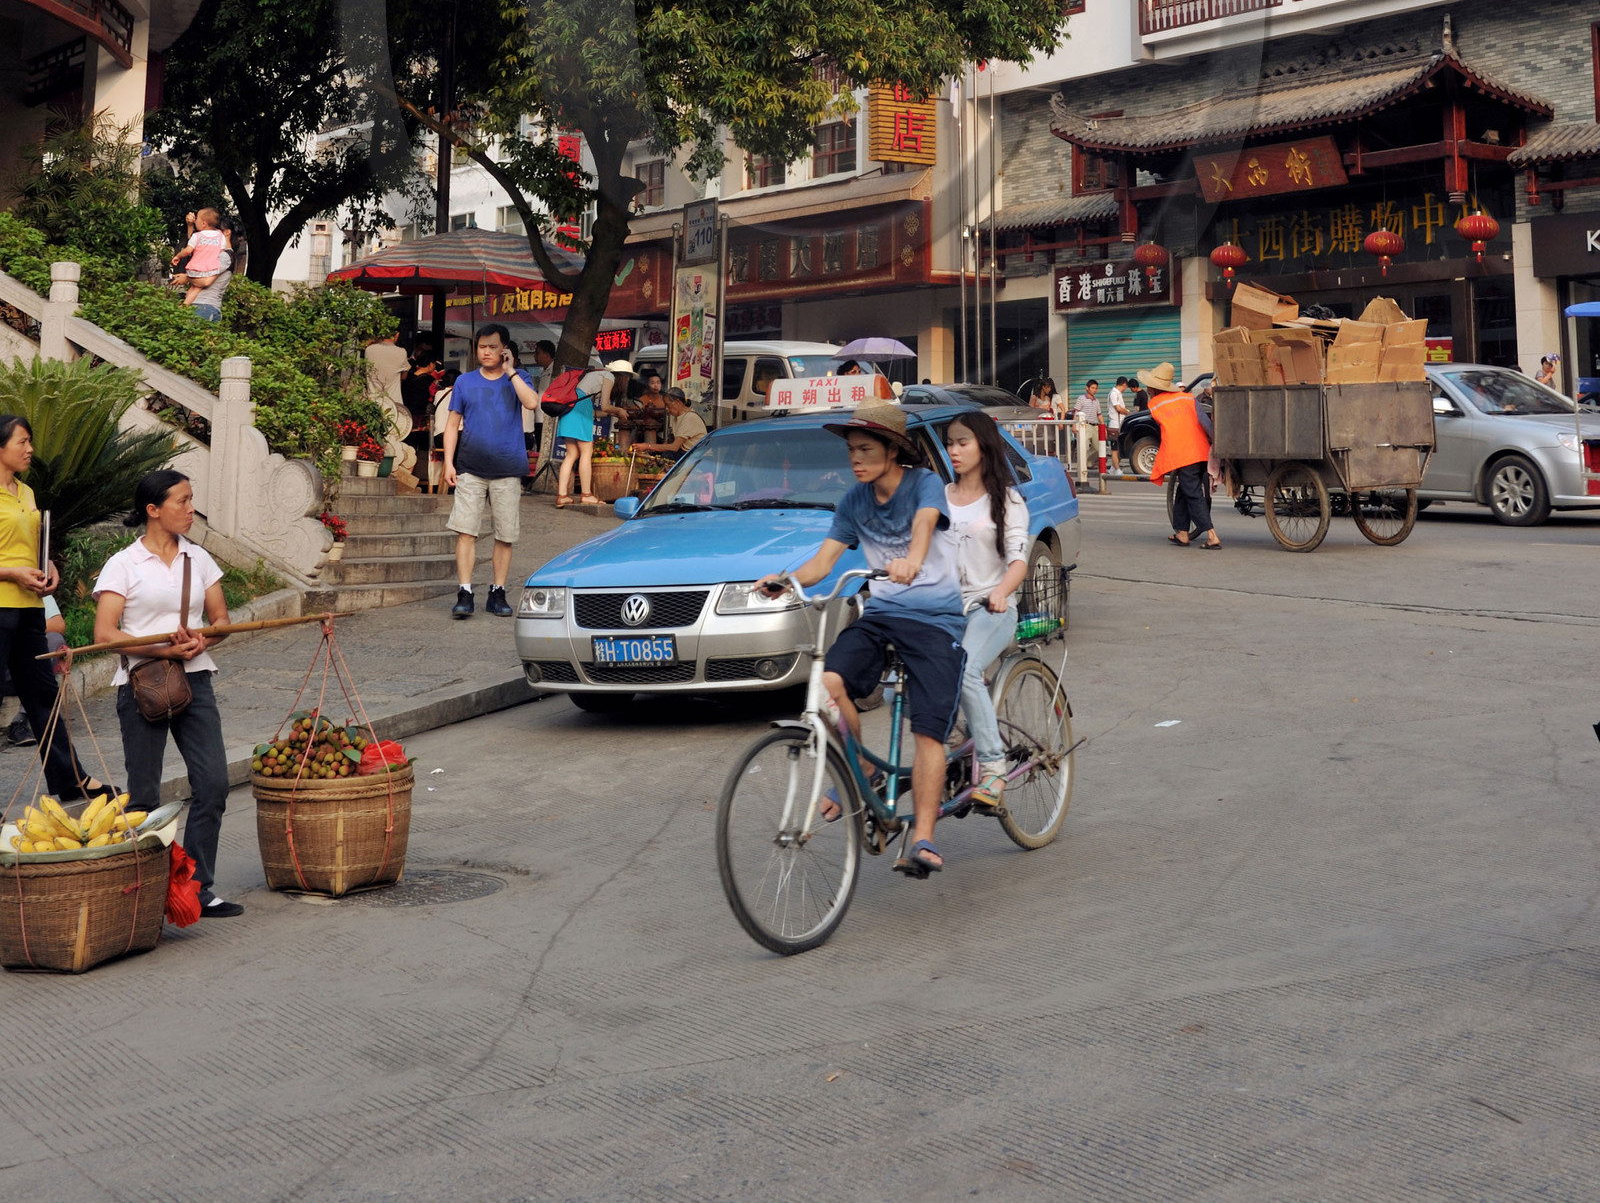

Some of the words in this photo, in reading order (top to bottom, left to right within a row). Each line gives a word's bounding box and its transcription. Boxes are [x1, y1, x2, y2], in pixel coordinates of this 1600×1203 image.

[695, 226, 713, 247] 110
[1058, 273, 1093, 303] 香港
[595, 329, 631, 351] 友谊商务
[809, 378, 839, 388] TAXI
[777, 386, 866, 406] 阳朔出租
